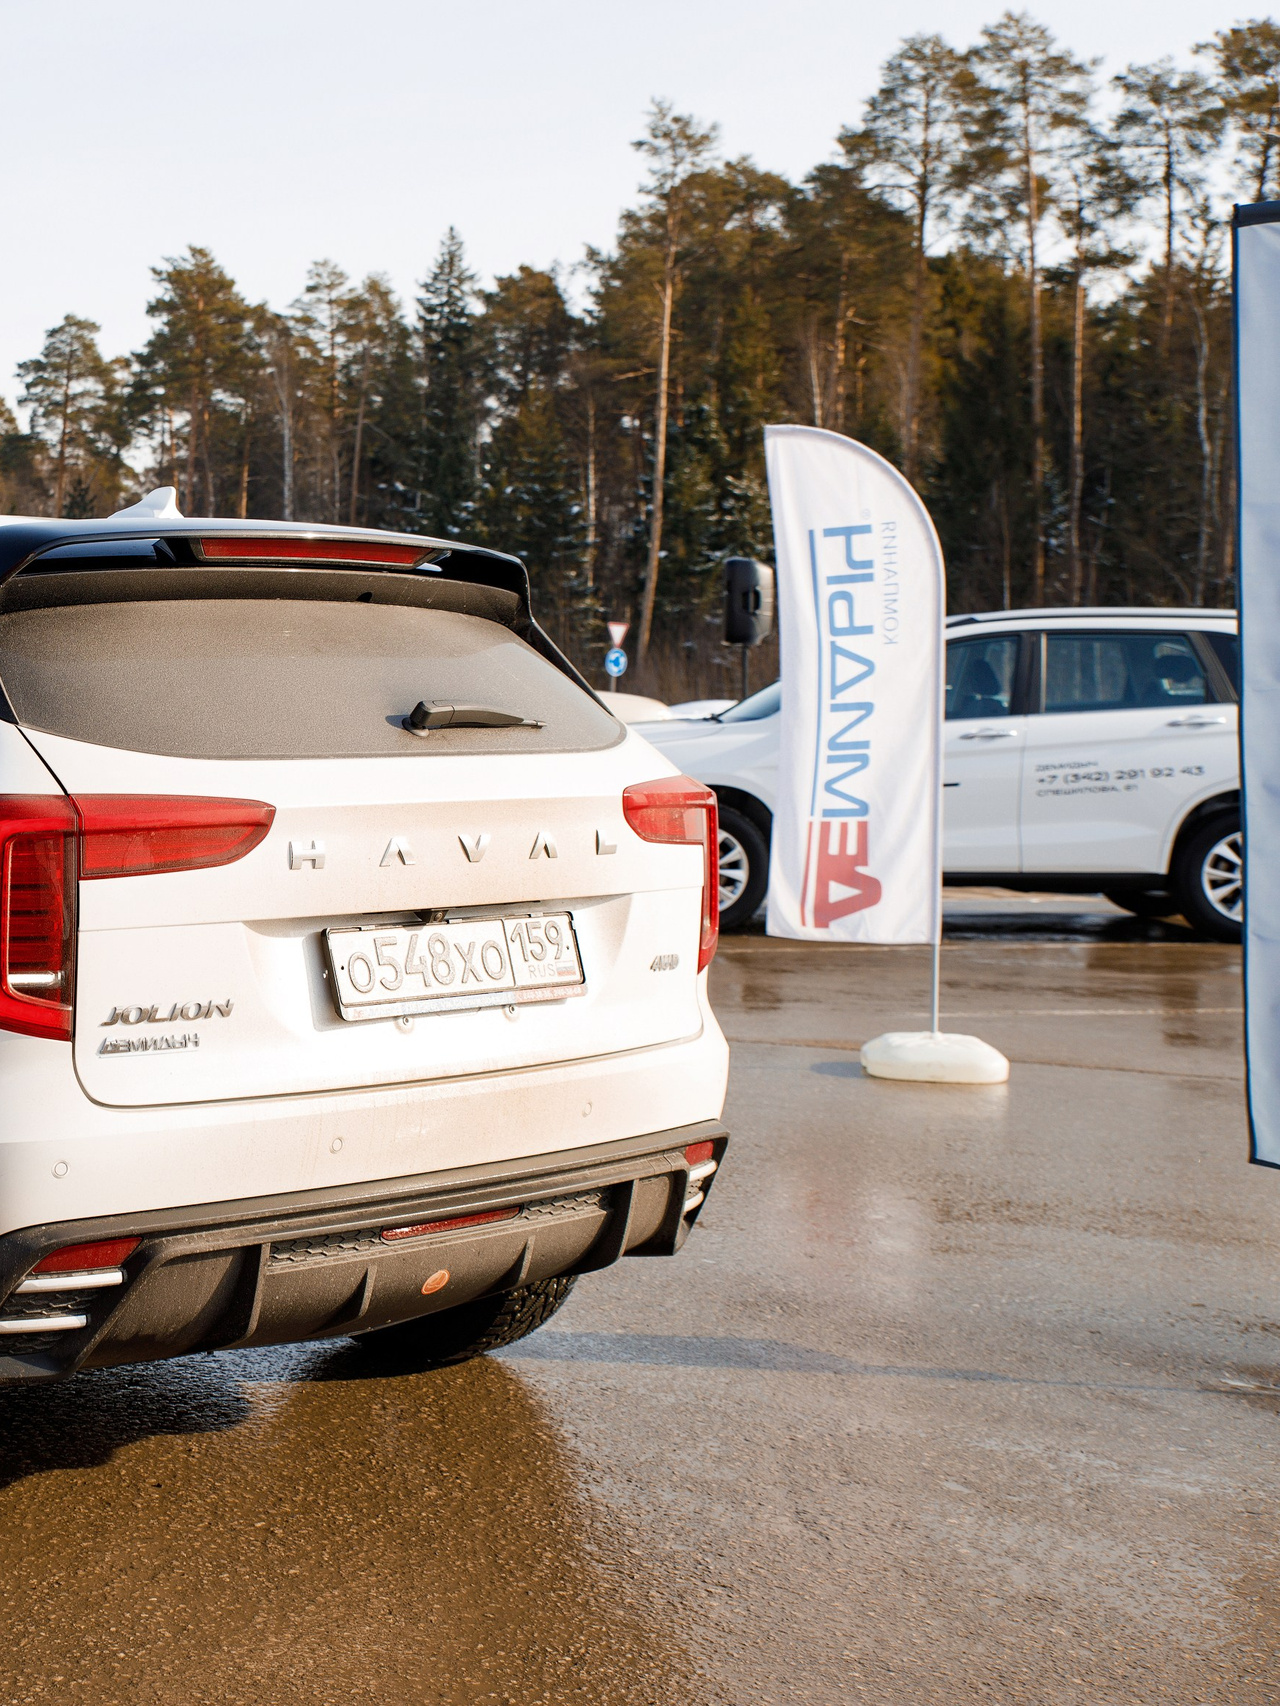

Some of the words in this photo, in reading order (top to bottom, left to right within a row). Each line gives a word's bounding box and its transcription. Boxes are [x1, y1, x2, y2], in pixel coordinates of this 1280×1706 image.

[1115, 768, 1146, 780] 291
[1149, 767, 1174, 778] 92
[1180, 765, 1205, 776] 43
[288, 829, 618, 870] HAVAL
[510, 920, 563, 962] 159
[528, 962, 557, 980] RUS
[97, 998, 235, 1028] JOLION
[96, 1033, 200, 1055] ДЕМИДЫЧ
